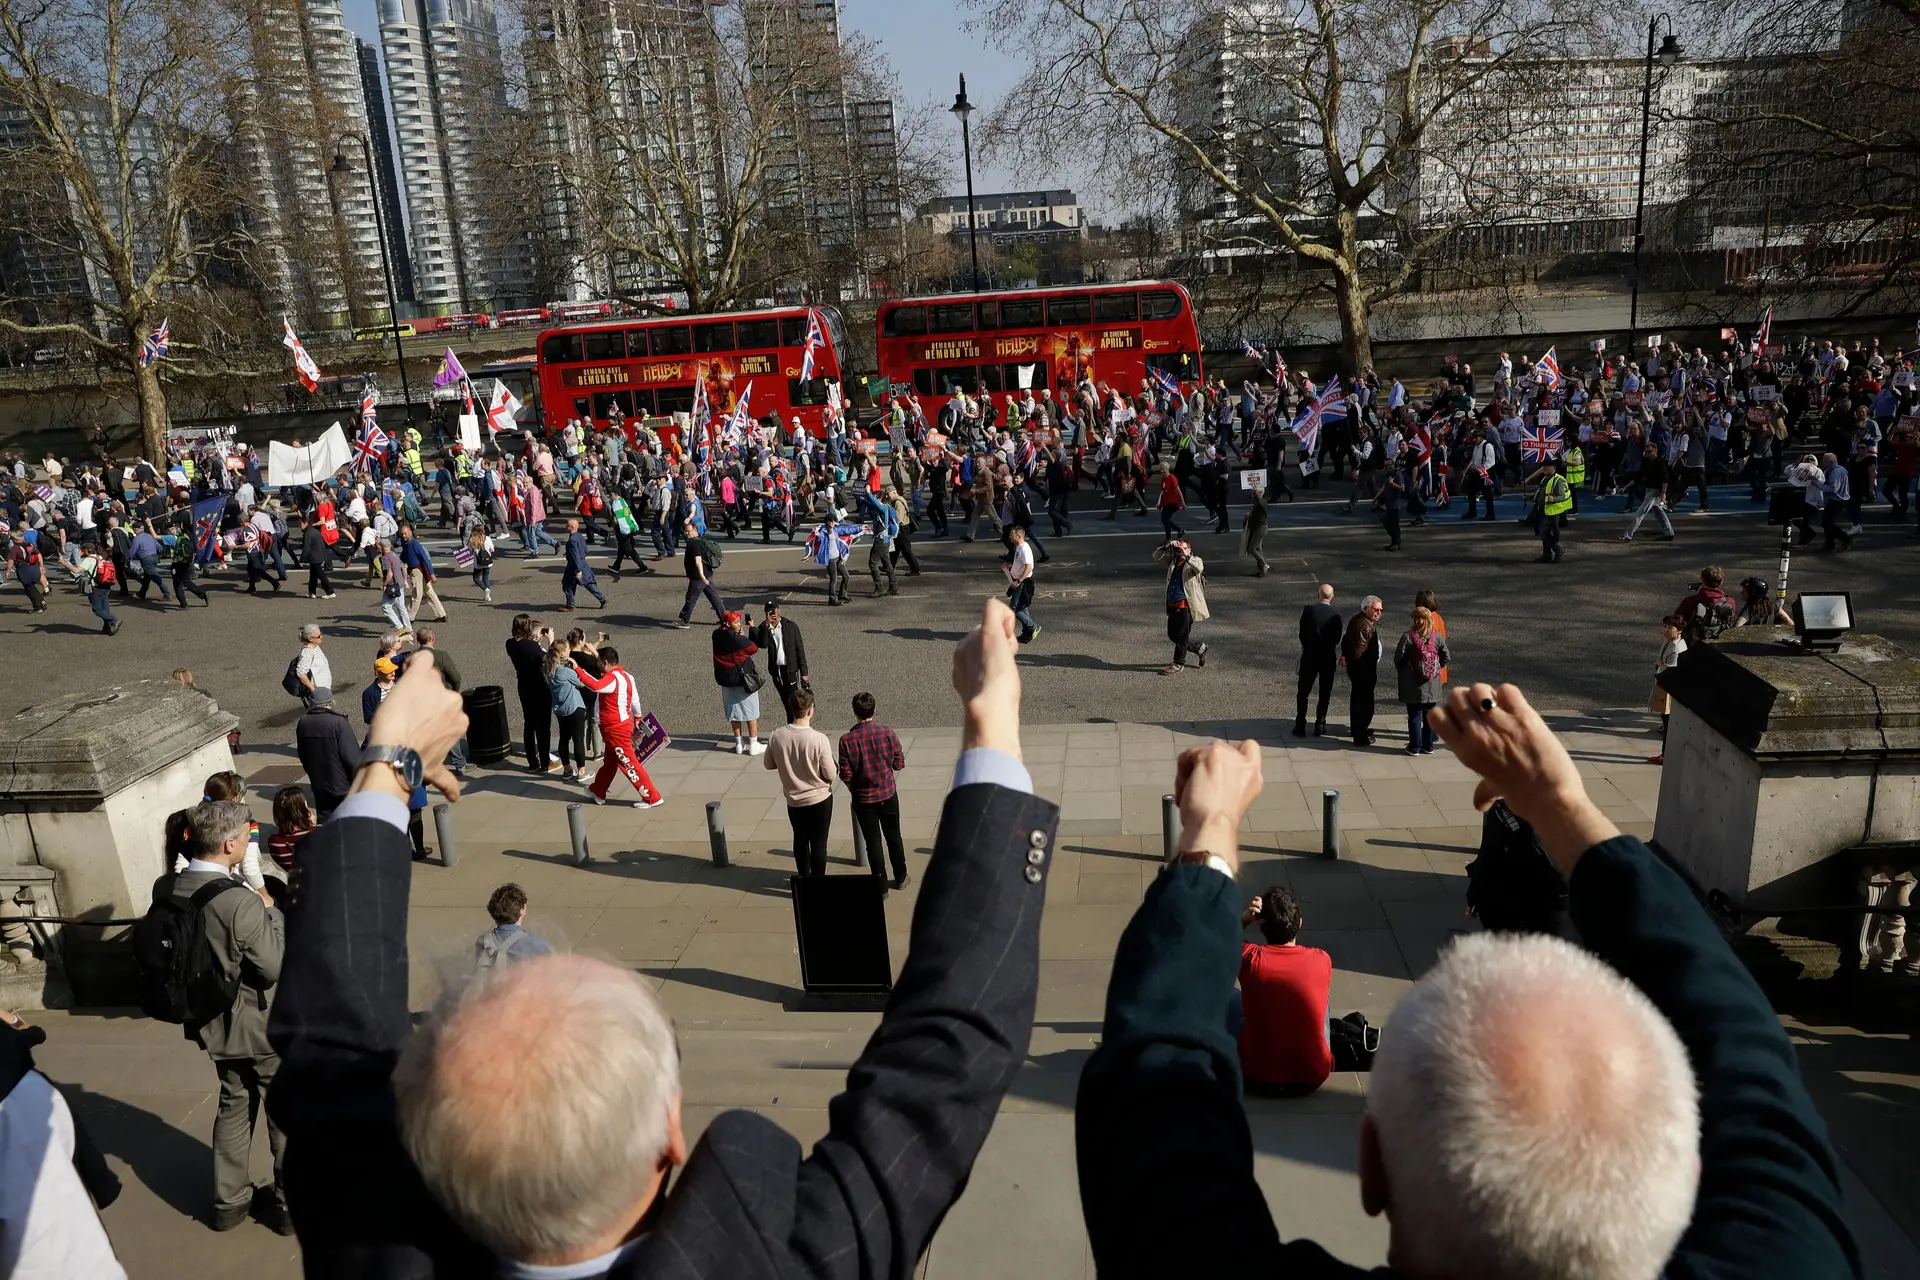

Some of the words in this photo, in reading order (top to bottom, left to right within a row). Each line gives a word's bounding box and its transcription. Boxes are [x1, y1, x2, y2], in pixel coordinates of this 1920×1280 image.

[931, 341, 956, 350] DEMONS
[958, 340, 972, 348] HAVE
[996, 336, 1040, 357] HELLBOY
[1100, 337, 1124, 349] APRIL
[1126, 336, 1133, 347] 11
[925, 348, 961, 360] DEMONS
[964, 346, 980, 357] TOO
[583, 367, 605, 376] DEMONS
[607, 366, 621, 374] HAVE
[642, 362, 685, 383] HELLBOY
[740, 363, 762, 374] APRIL
[763, 362, 771, 373] 11
[578, 374, 611, 386] DEMONS
[614, 372, 629, 383] TOO
